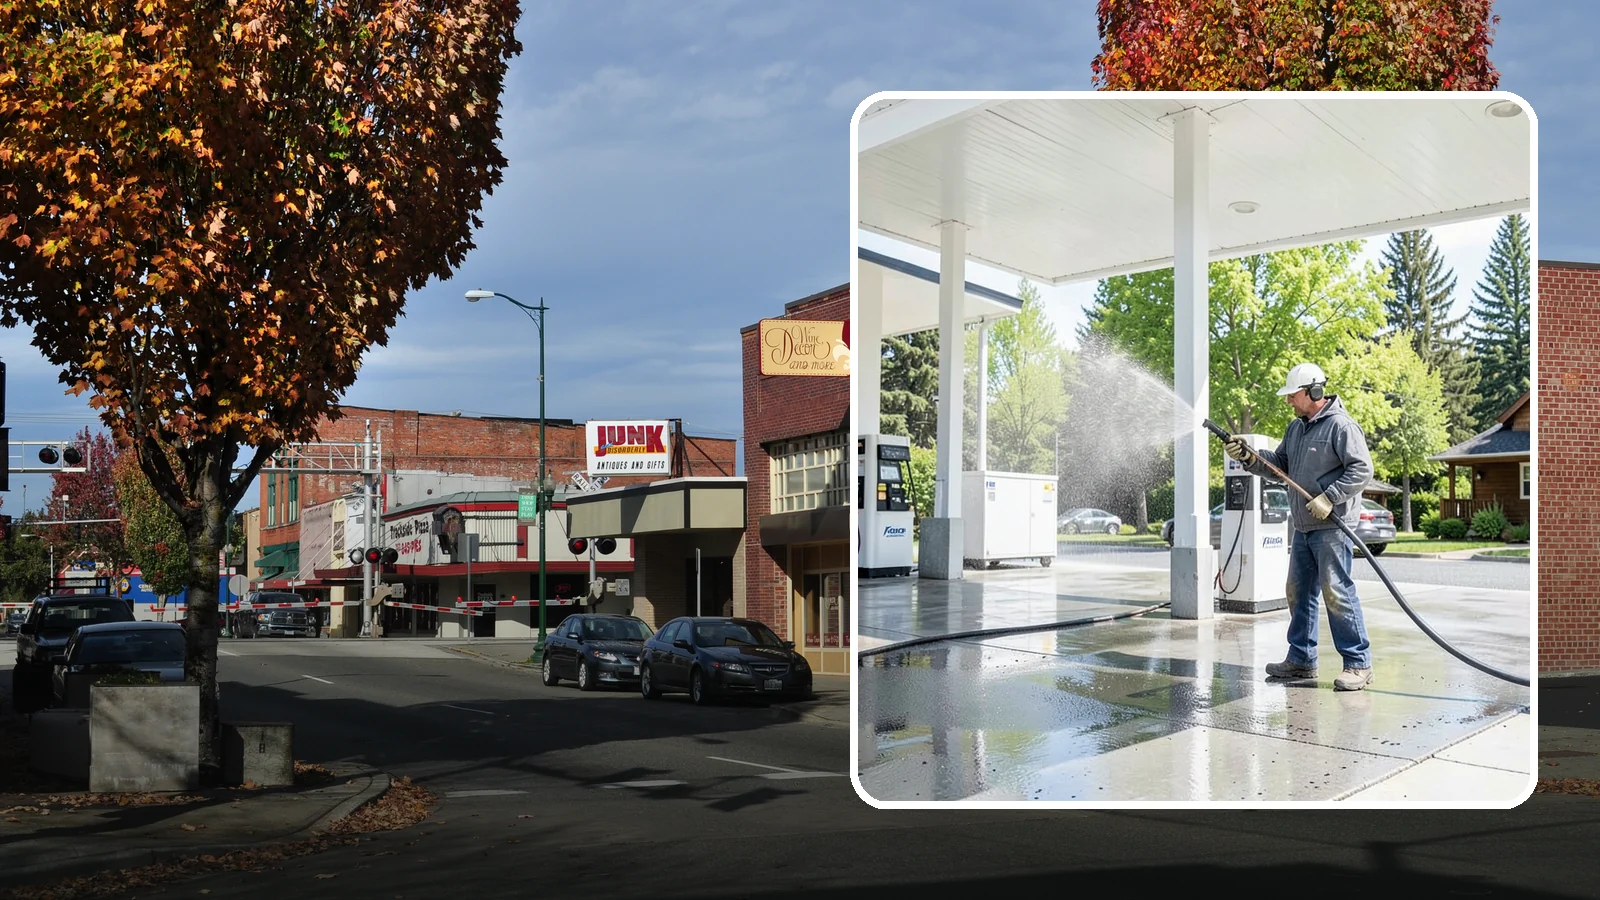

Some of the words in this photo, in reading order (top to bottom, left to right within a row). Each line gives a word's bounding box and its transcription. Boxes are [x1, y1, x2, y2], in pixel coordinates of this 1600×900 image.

[596, 425, 665, 457] JUNK
[597, 461, 628, 470] ANTIQUES
[631, 461, 644, 470] AND
[647, 460, 665, 469] GIFTS
[390, 521, 413, 539] Trackside
[414, 519, 429, 535] Pizza
